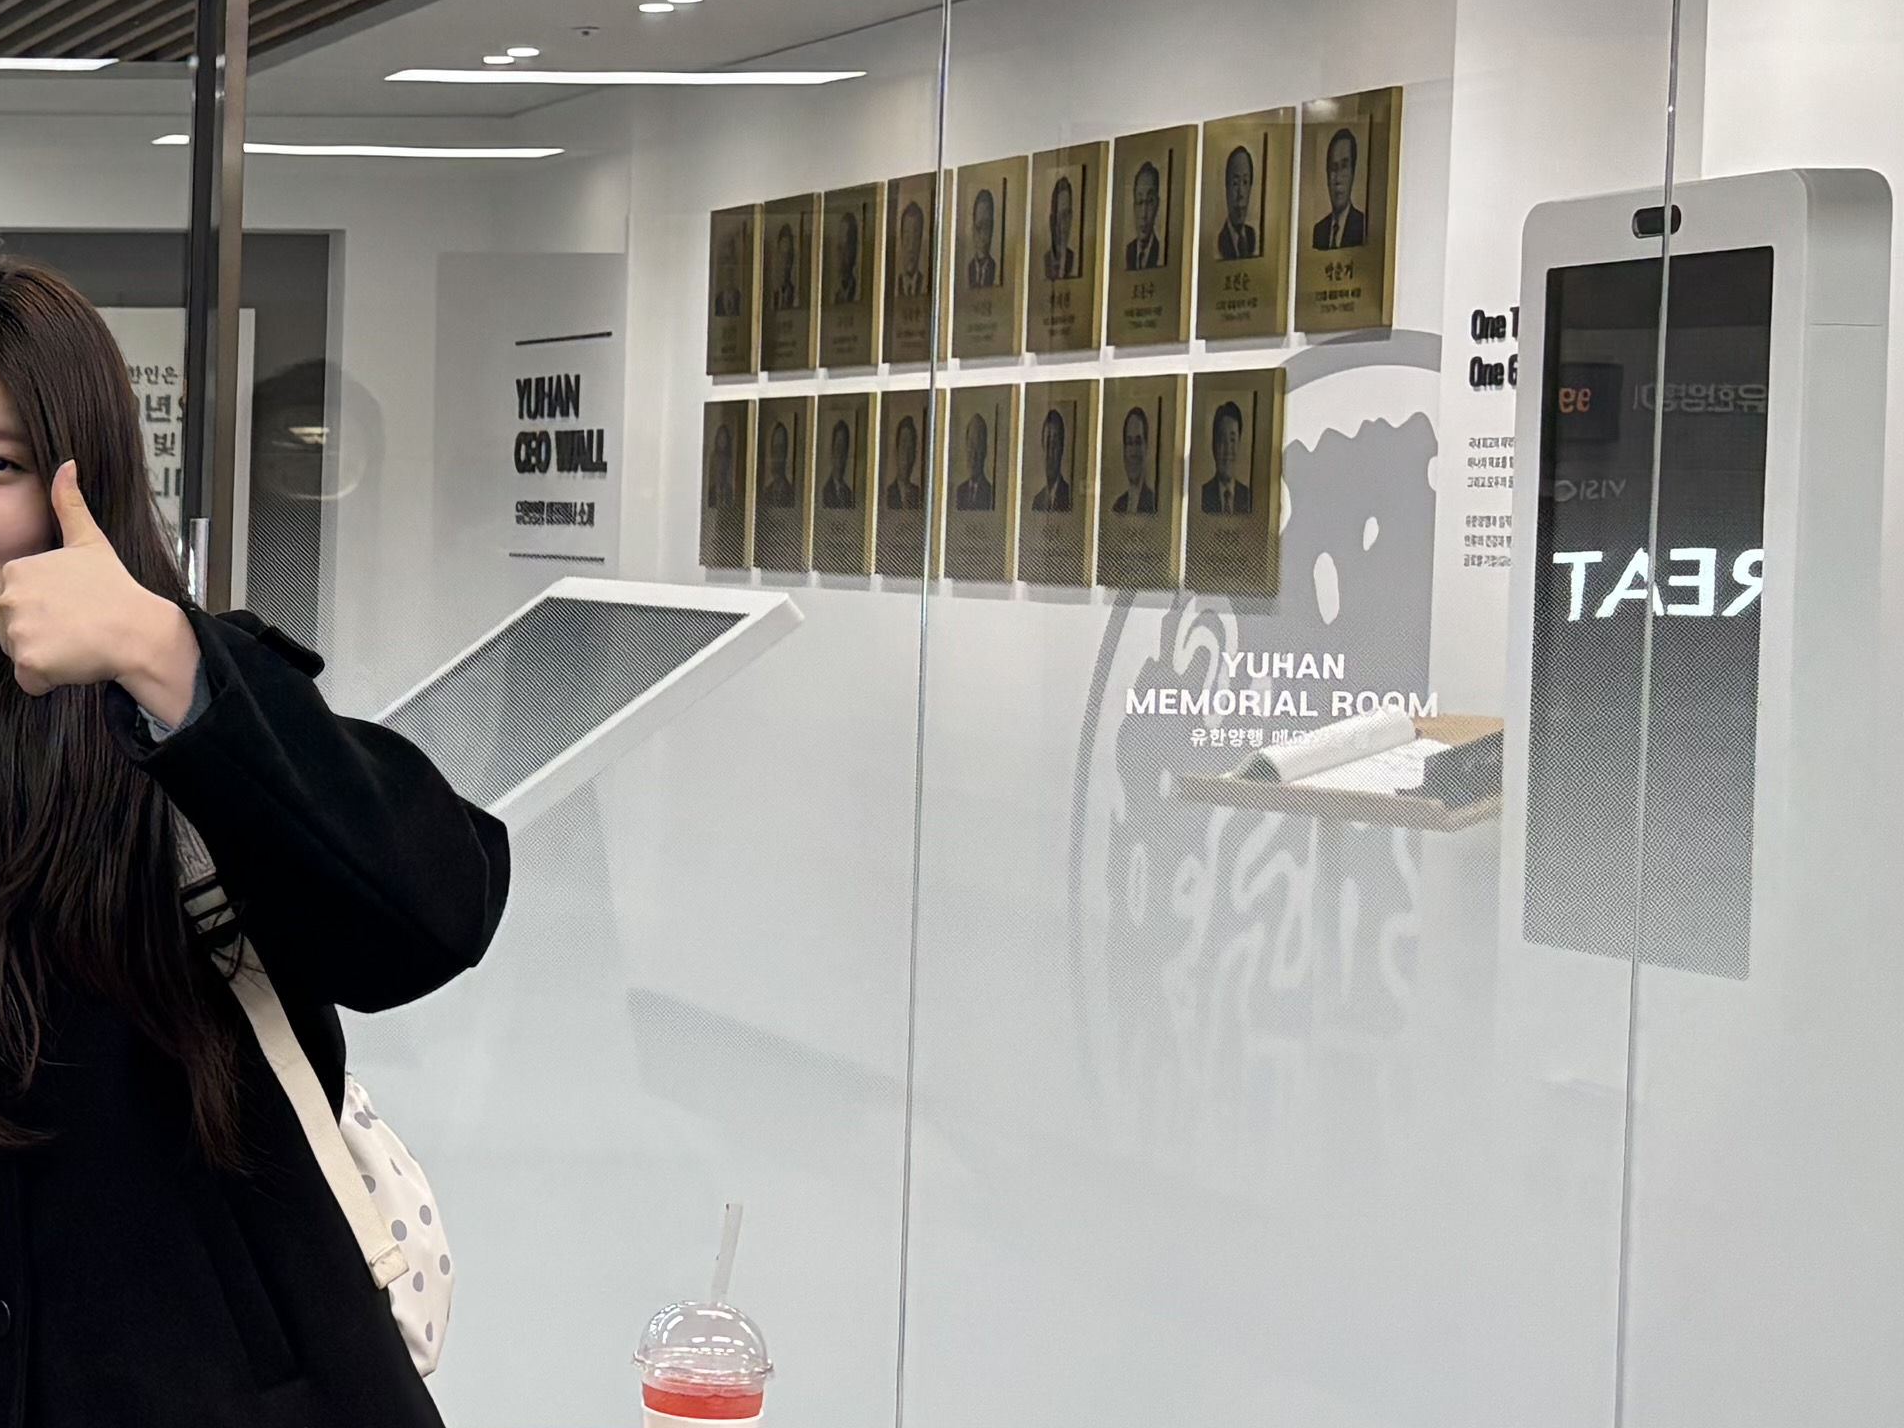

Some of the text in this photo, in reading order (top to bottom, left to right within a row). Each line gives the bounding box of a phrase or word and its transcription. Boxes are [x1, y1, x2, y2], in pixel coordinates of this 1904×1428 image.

[1470, 309, 1507, 341] One
[1469, 355, 1505, 389] One
[515, 373, 581, 419] YUHAN
[514, 429, 608, 475] CEO WALL
[1222, 651, 1345, 680] YUHAN
[1125, 687, 1439, 719] MEMORIAL ROOM
[1190, 727, 1264, 748] 유한양행
